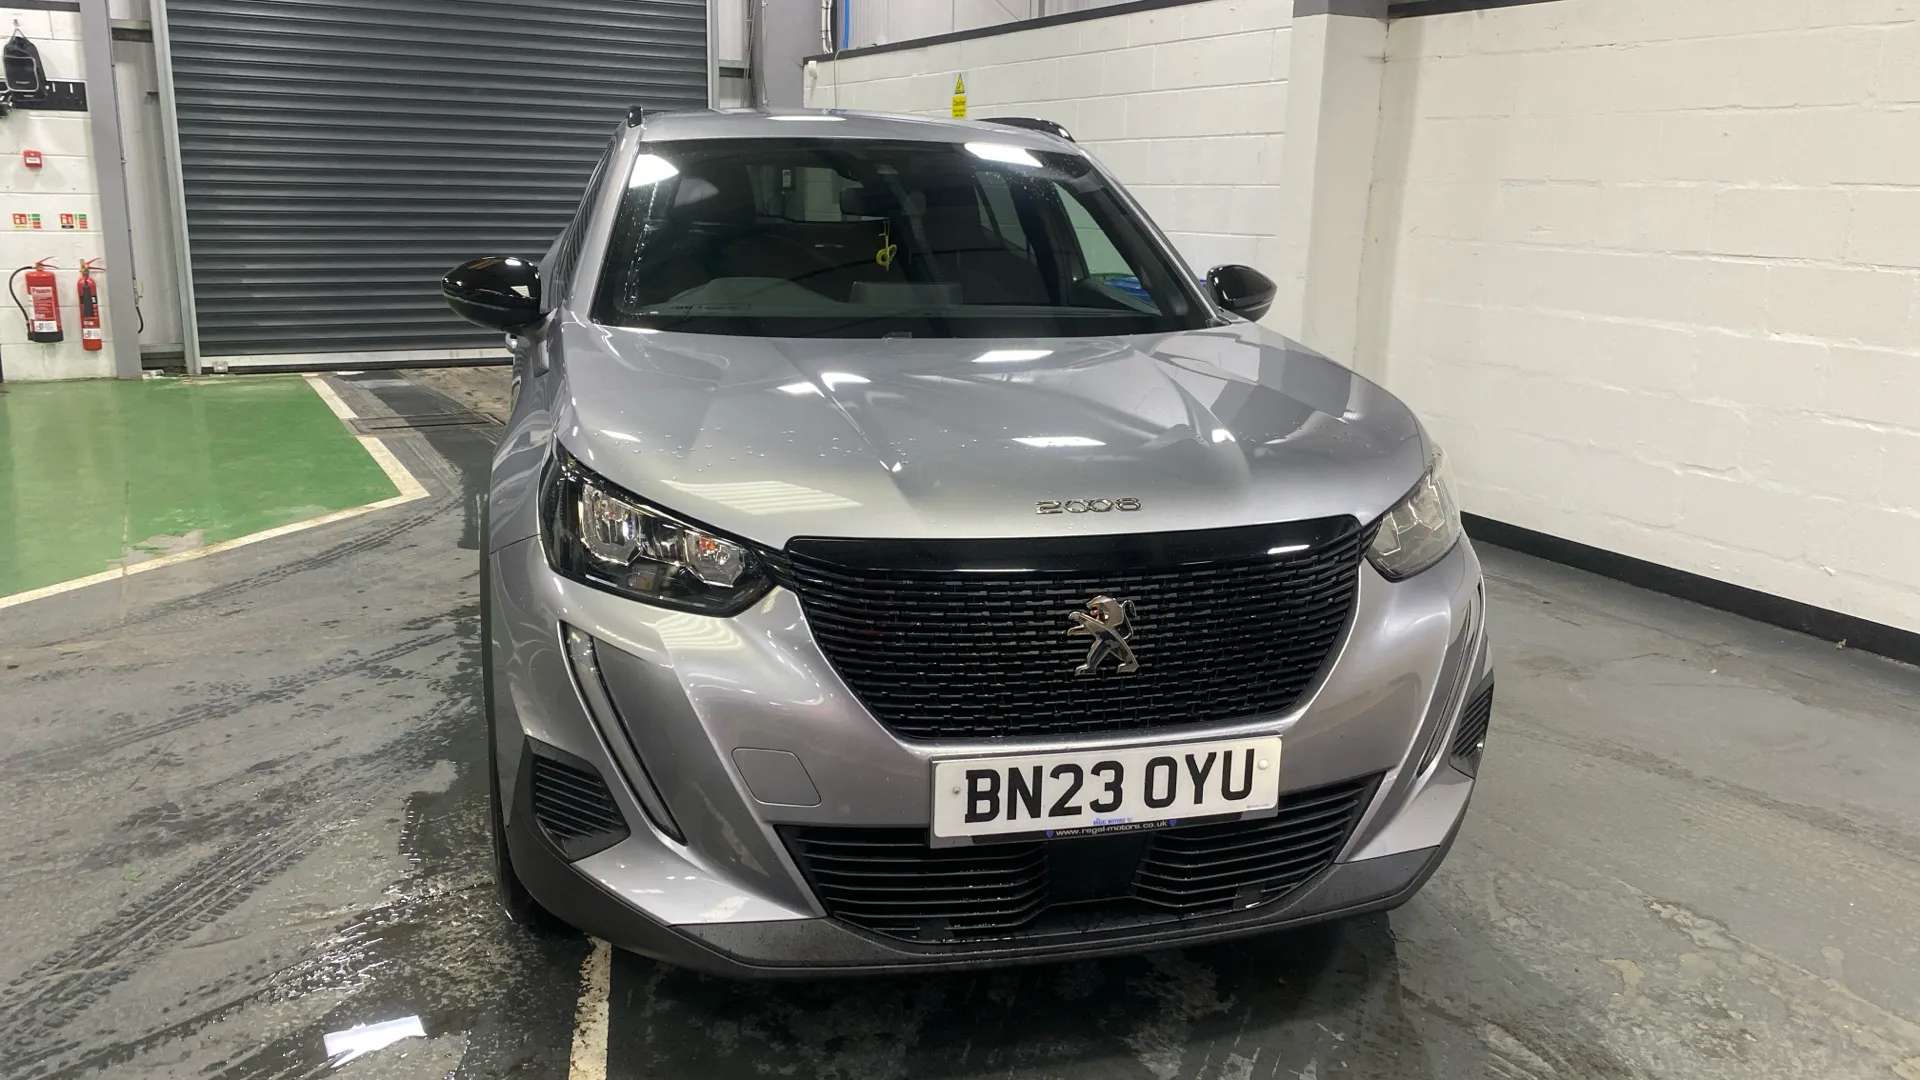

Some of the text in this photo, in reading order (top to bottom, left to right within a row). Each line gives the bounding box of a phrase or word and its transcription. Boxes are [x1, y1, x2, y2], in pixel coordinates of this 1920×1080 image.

[1036, 498, 1141, 514] 2008
[965, 748, 1255, 823] BN23 OYU
[1056, 820, 1168, 836] www.regal-motors.co.uk
